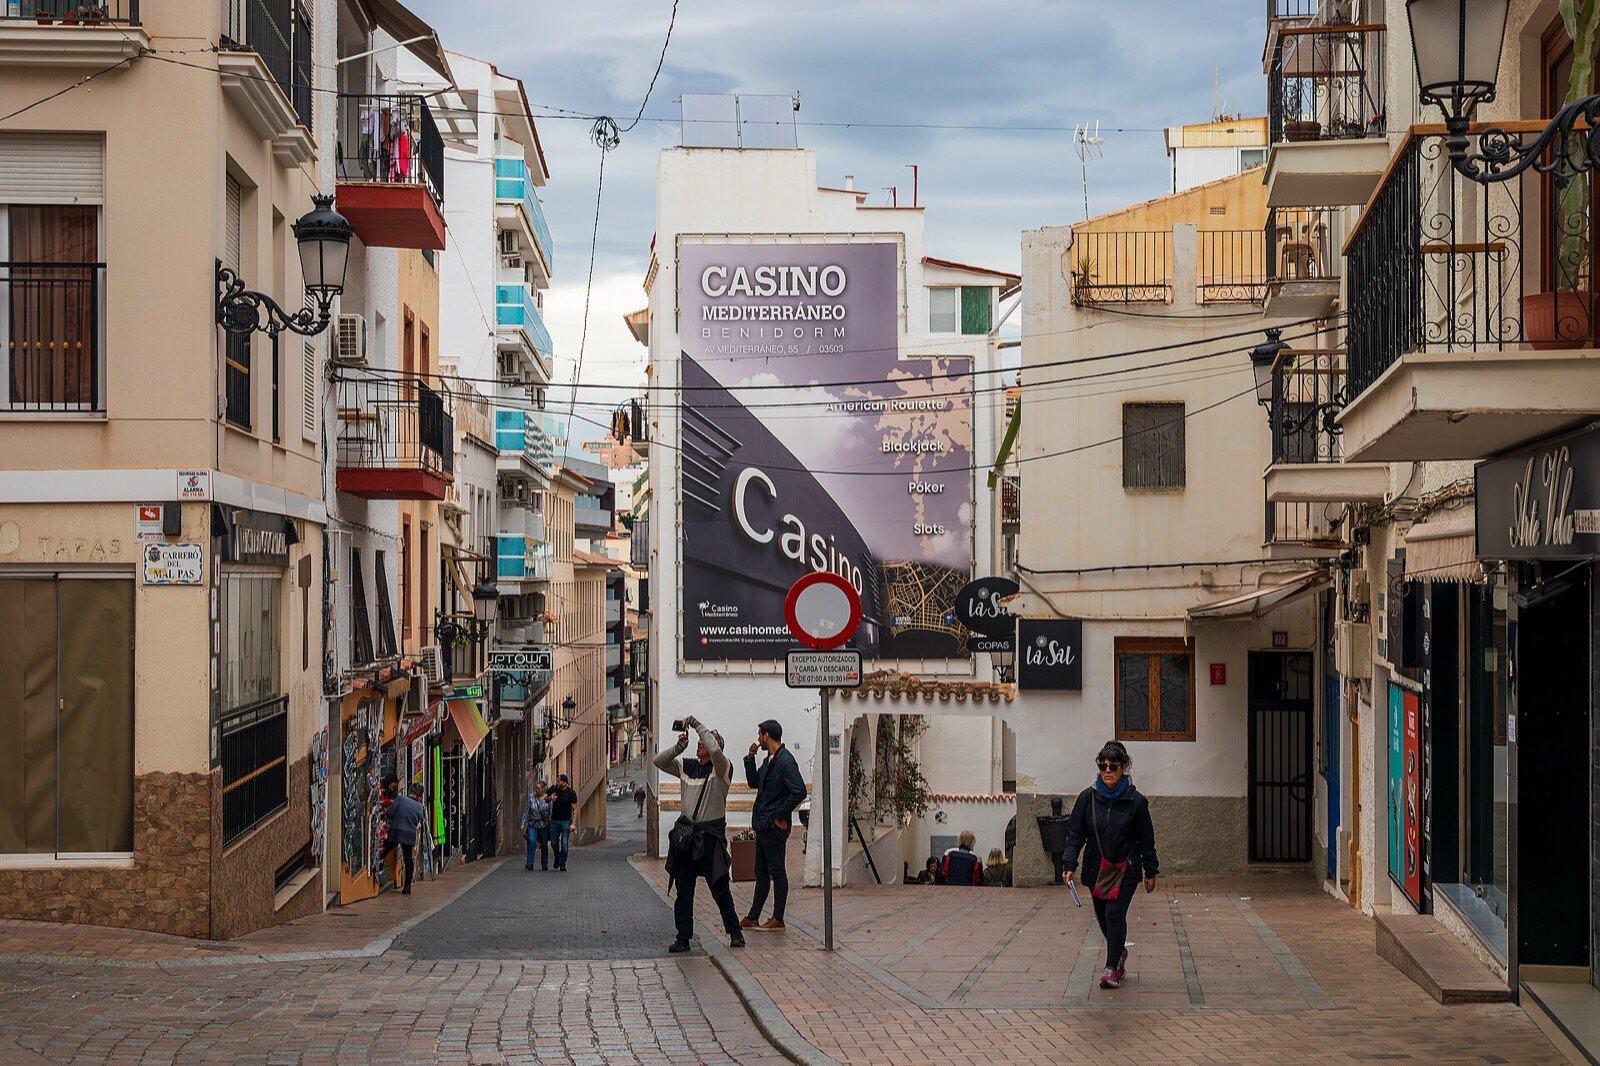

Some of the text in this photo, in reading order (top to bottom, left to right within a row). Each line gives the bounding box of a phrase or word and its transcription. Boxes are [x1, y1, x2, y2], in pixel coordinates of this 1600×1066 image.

[701, 265, 847, 298] CASINO
[702, 301, 846, 322] MEDITERRÁNEO
[702, 327, 846, 339] BENIDORM
[819, 345, 844, 354] 03503
[825, 399, 944, 412] American Roulette
[882, 440, 944, 454] Blackjack
[908, 481, 945, 494] Póker
[732, 466, 863, 597] Casino
[913, 522, 945, 535] Slots
[38, 537, 121, 561] TAPAS
[162, 550, 199, 560] CARRERÓ
[153, 569, 195, 579] MAL PAS
[711, 603, 738, 613] Casino
[977, 640, 1010, 650] COPAS
[792, 655, 856, 663] EXCEPTO AUTORIZADOS
[1046, 640, 1076, 666] Sal
[799, 665, 818, 673] CARGA
